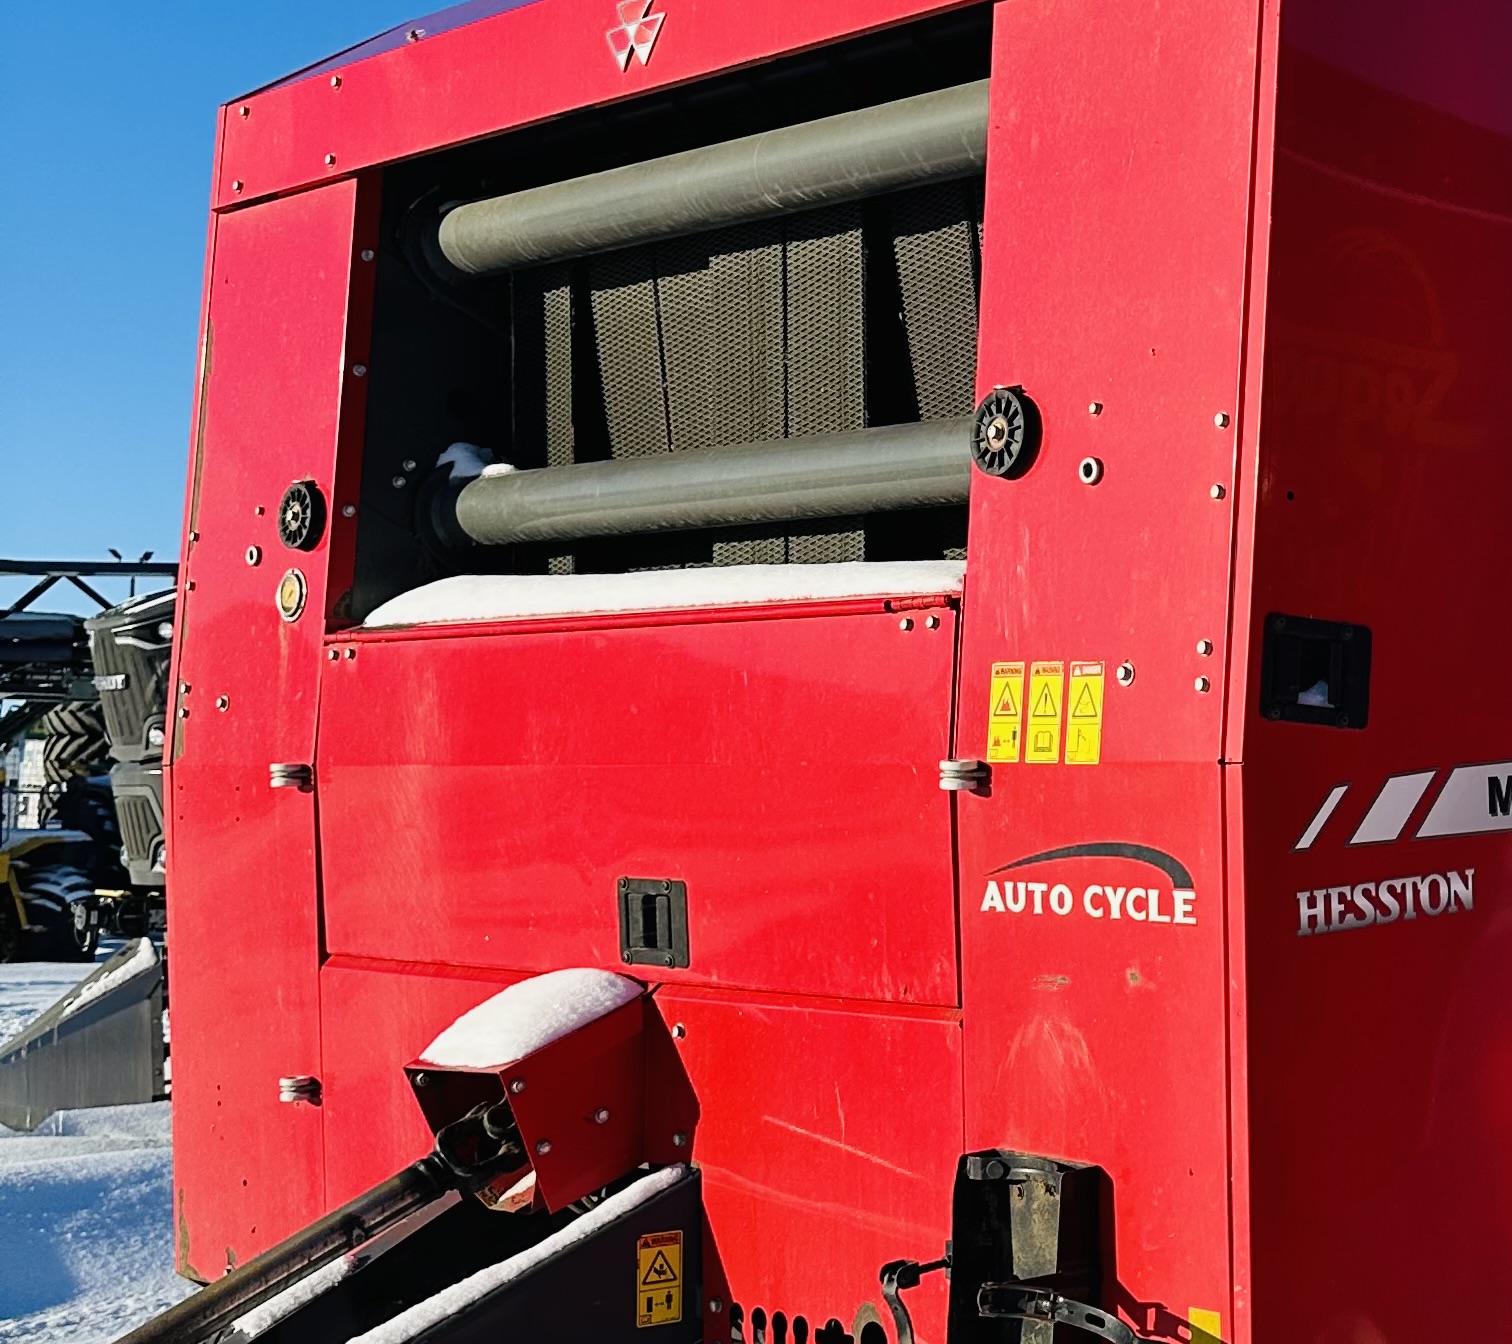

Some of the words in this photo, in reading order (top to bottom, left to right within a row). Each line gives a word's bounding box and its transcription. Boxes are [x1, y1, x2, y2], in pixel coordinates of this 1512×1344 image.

[980, 881, 1073, 916] AUTO
[1083, 885, 1197, 924] CYCLE
[1297, 868, 1475, 937] HESSTON
